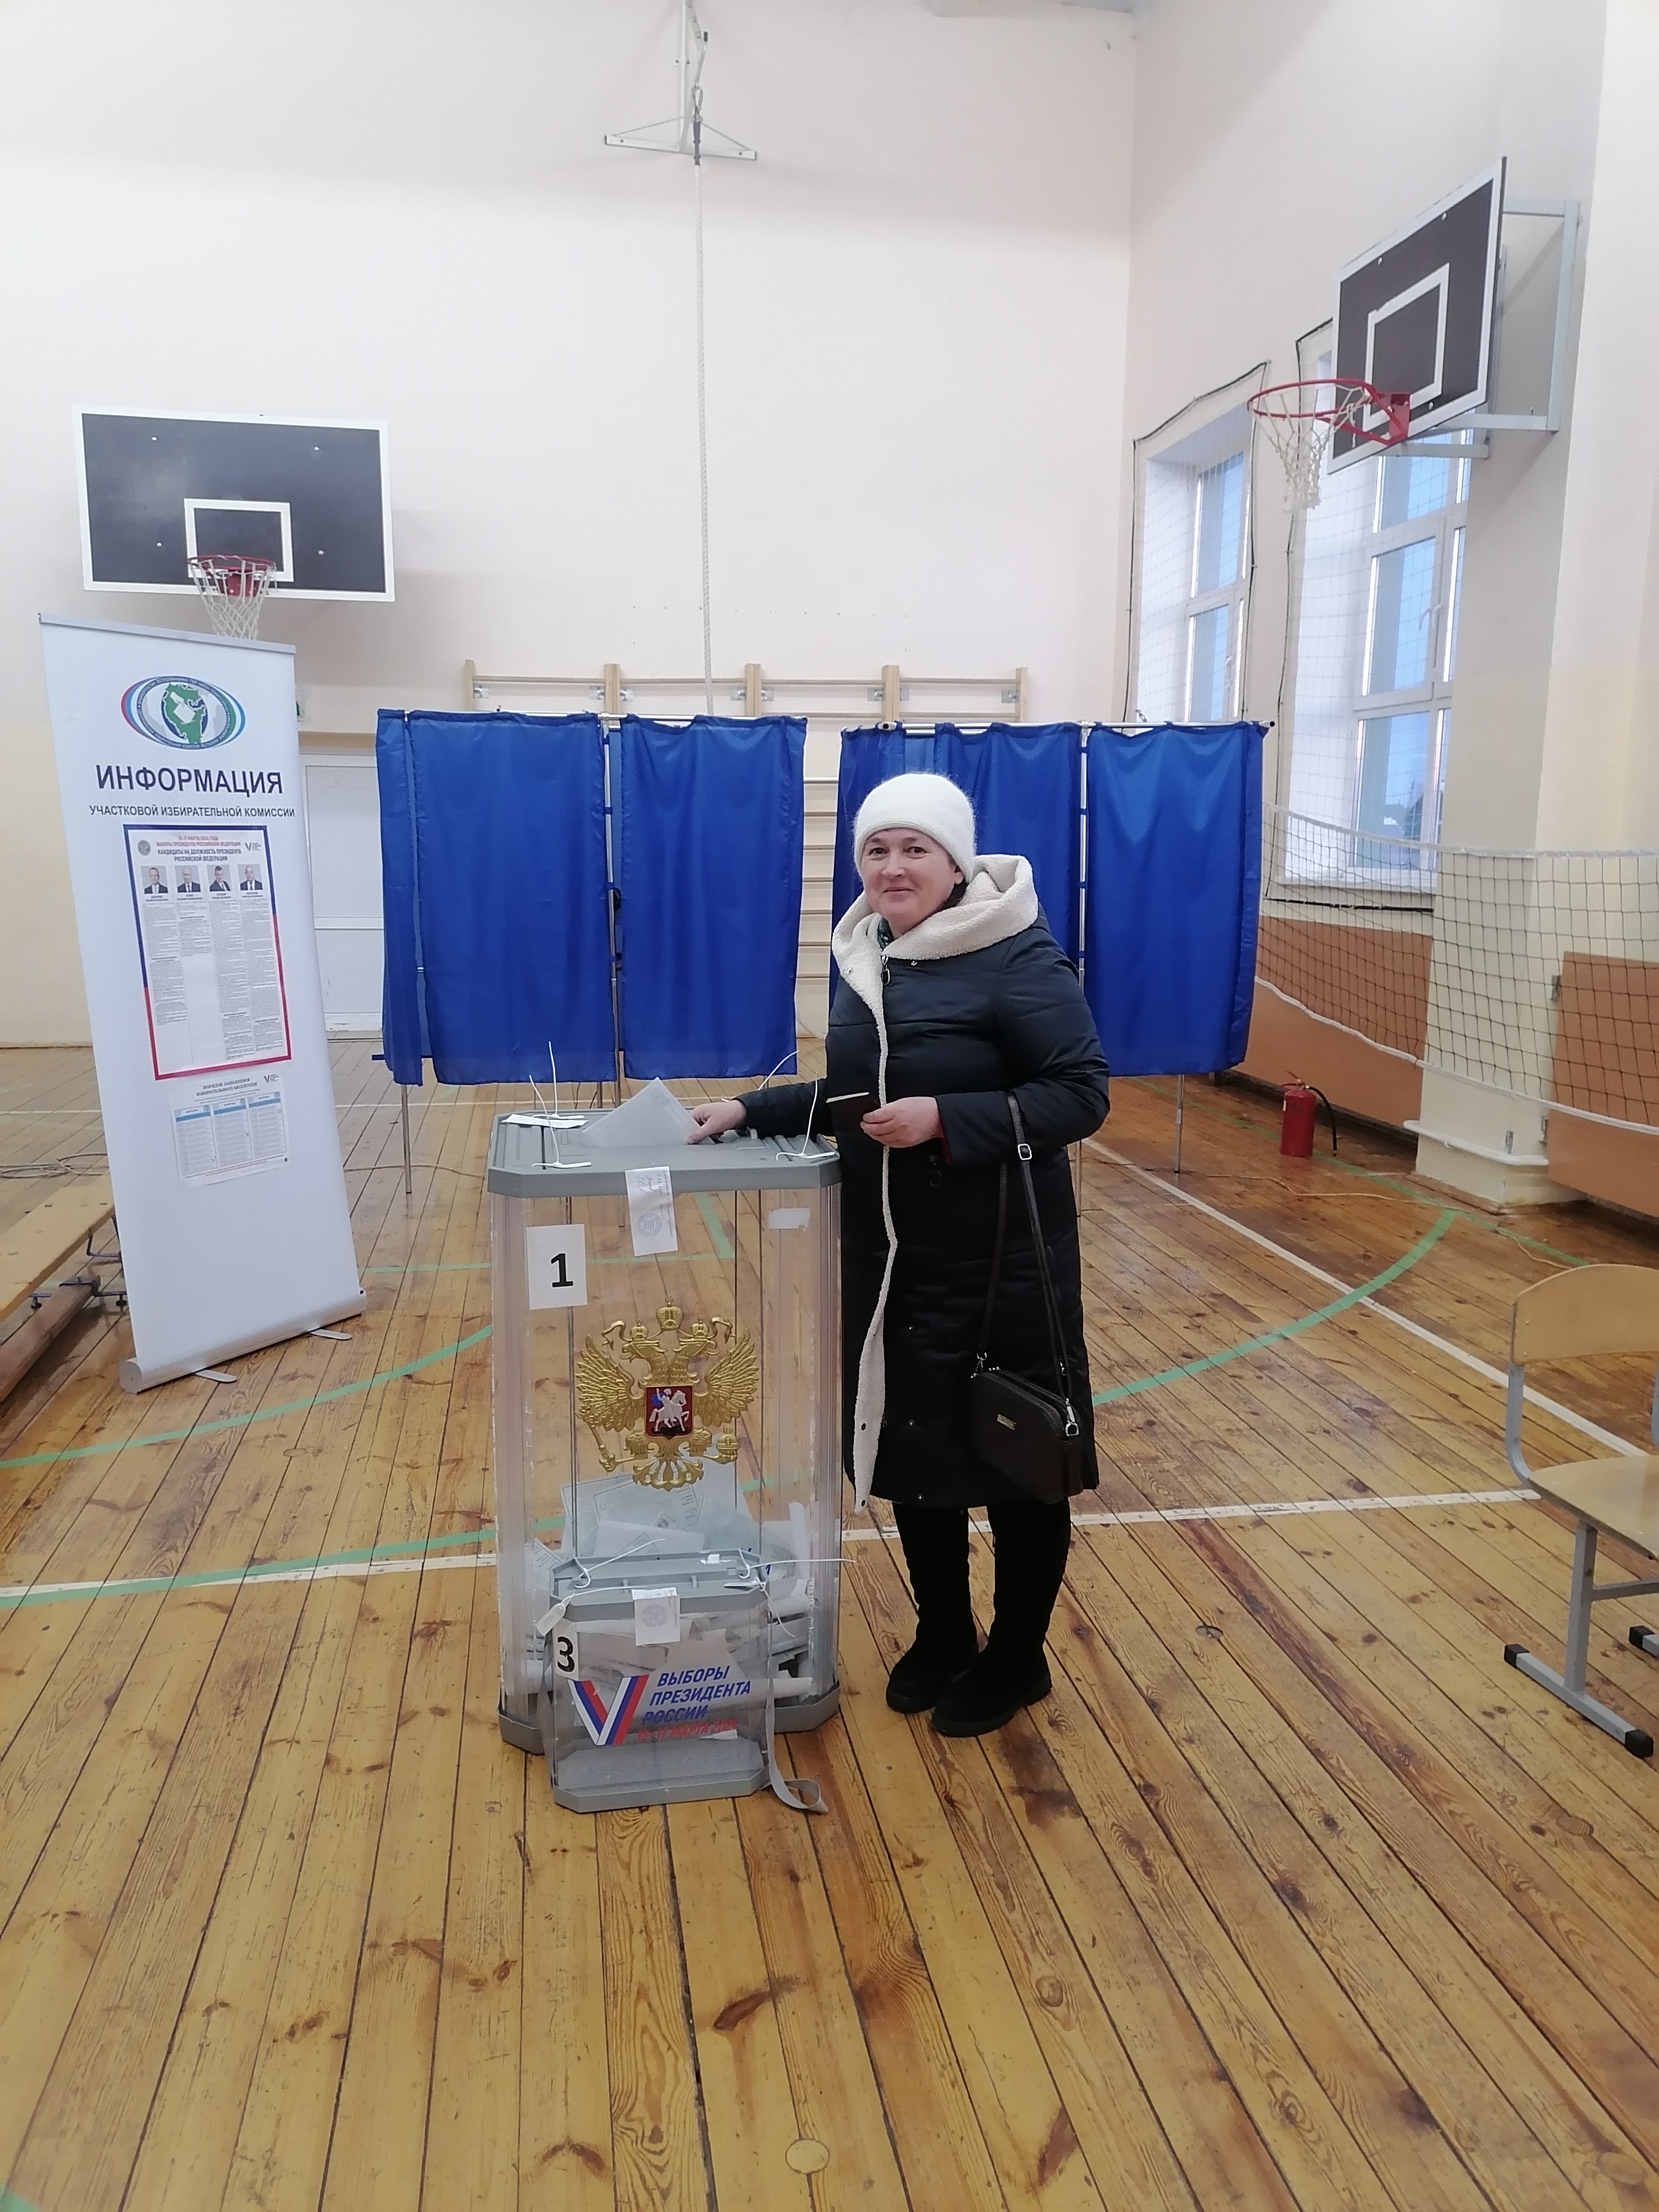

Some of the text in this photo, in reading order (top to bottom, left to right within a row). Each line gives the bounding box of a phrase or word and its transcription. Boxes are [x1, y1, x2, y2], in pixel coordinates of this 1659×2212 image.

[96, 764, 283, 797] ИНФОРМАЦИЯ
[89, 804, 295, 817] УЧАСТКОВОЙ ИЗБИРАТЕЛЬНОЙ КОМИССИИ
[551, 1253, 573, 1287] 1
[557, 1636, 575, 1672] 3
[657, 1666, 731, 1687] ВЫБОРЫ
[649, 1681, 752, 1706] ПРЕЗИДЕНТА
[641, 1705, 708, 1725] РОССИИ
[670, 1721, 709, 1737] МАРТА
